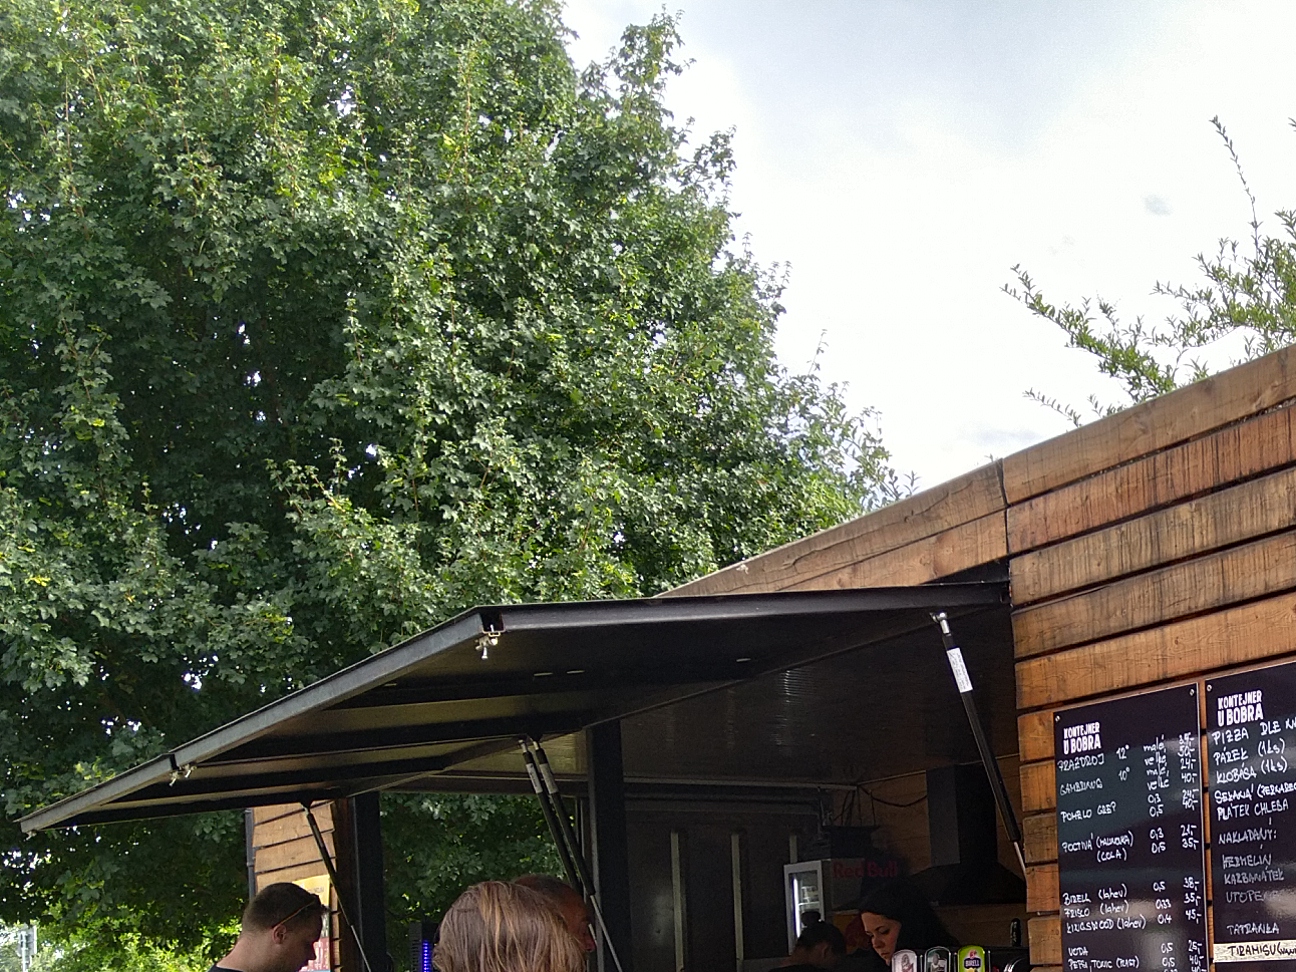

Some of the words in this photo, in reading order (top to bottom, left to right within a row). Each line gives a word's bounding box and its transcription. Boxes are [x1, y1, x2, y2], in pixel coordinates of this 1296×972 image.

[1217, 690, 1262, 709] KONTEJNER
[1217, 710, 1224, 727] U
[1226, 703, 1264, 726] BOBRA
[1063, 721, 1100, 739] KONTEJNER
[1211, 727, 1249, 745] PIZZA
[1260, 720, 1282, 736] DLE
[1063, 739, 1069, 755] U
[1070, 733, 1102, 754] BOBRA
[833, 861, 864, 879] Red
[867, 860, 897, 878] Bull
